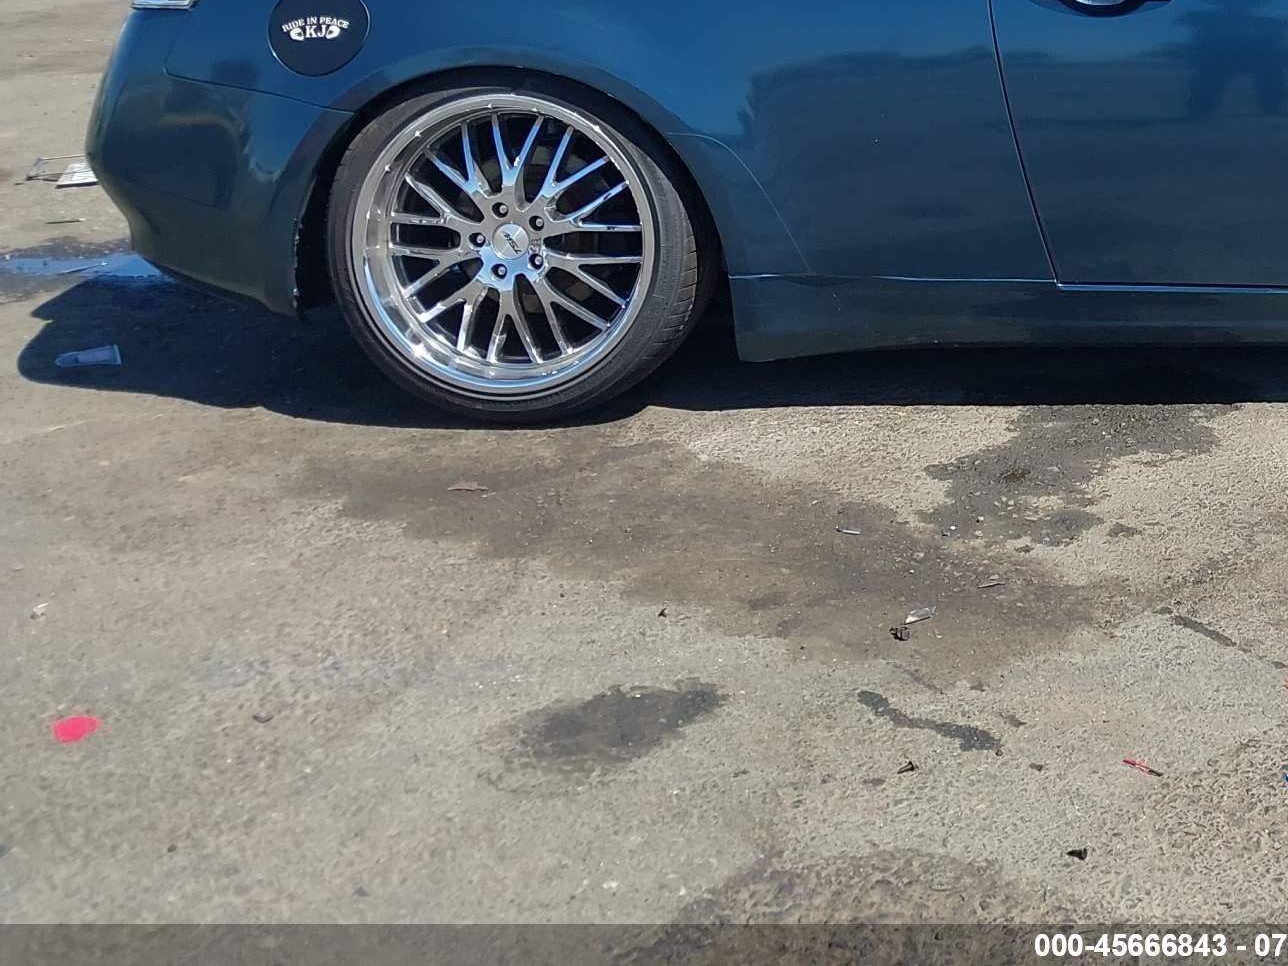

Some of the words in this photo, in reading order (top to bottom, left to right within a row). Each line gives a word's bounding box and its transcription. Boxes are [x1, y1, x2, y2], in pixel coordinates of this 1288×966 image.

[281, 18, 305, 33] RIDE
[306, 16, 318, 25] IN
[319, 16, 350, 29] PEACE
[305, 24, 328, 38] KJ
